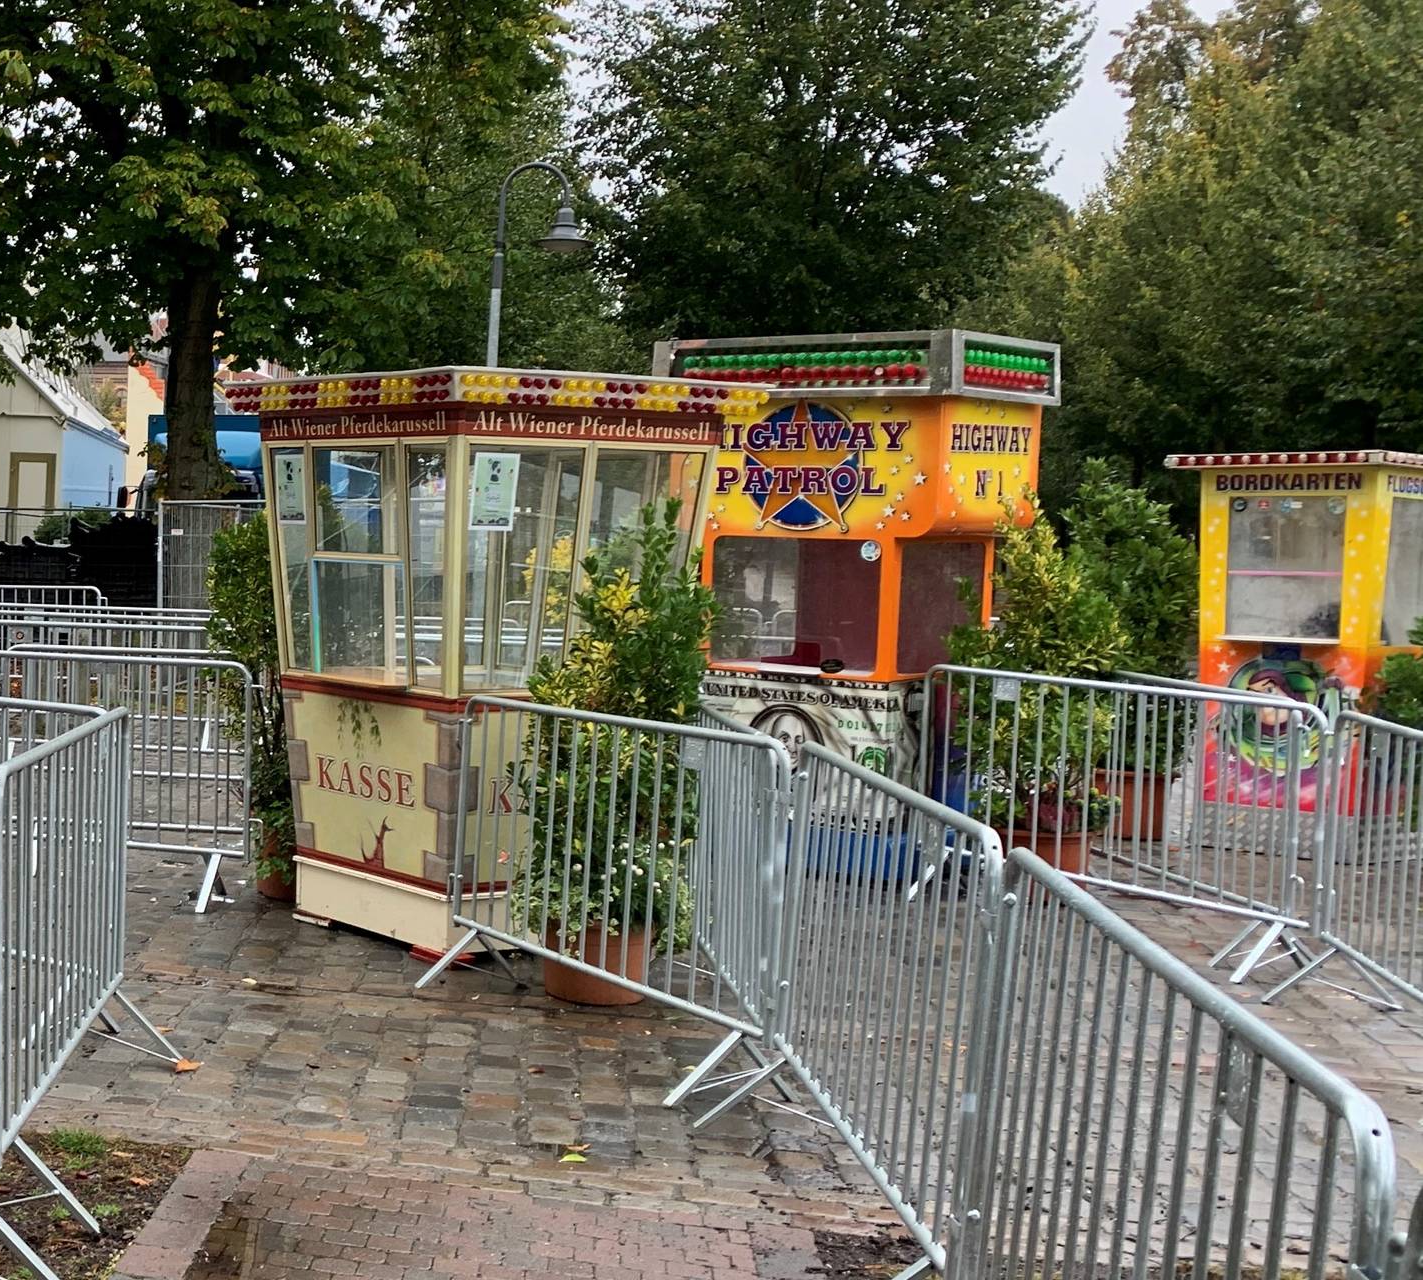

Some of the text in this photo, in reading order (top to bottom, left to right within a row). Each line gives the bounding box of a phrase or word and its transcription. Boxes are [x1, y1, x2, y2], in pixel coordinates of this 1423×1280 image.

[270, 410, 446, 437] Alt Wiener Pferdekarussell
[473, 410, 710, 441] Alt Wiener Pferdekarussell
[720, 421, 911, 451] IGHWAY
[950, 423, 1031, 454] HIGHWAY
[715, 465, 885, 495] PATROL
[1216, 472, 1363, 491] BORDKARTEN
[1387, 474, 1423, 493] FLUGS
[707, 682, 760, 698] UNITED
[761, 687, 818, 705] STATES
[316, 754, 416, 808] KASSE
